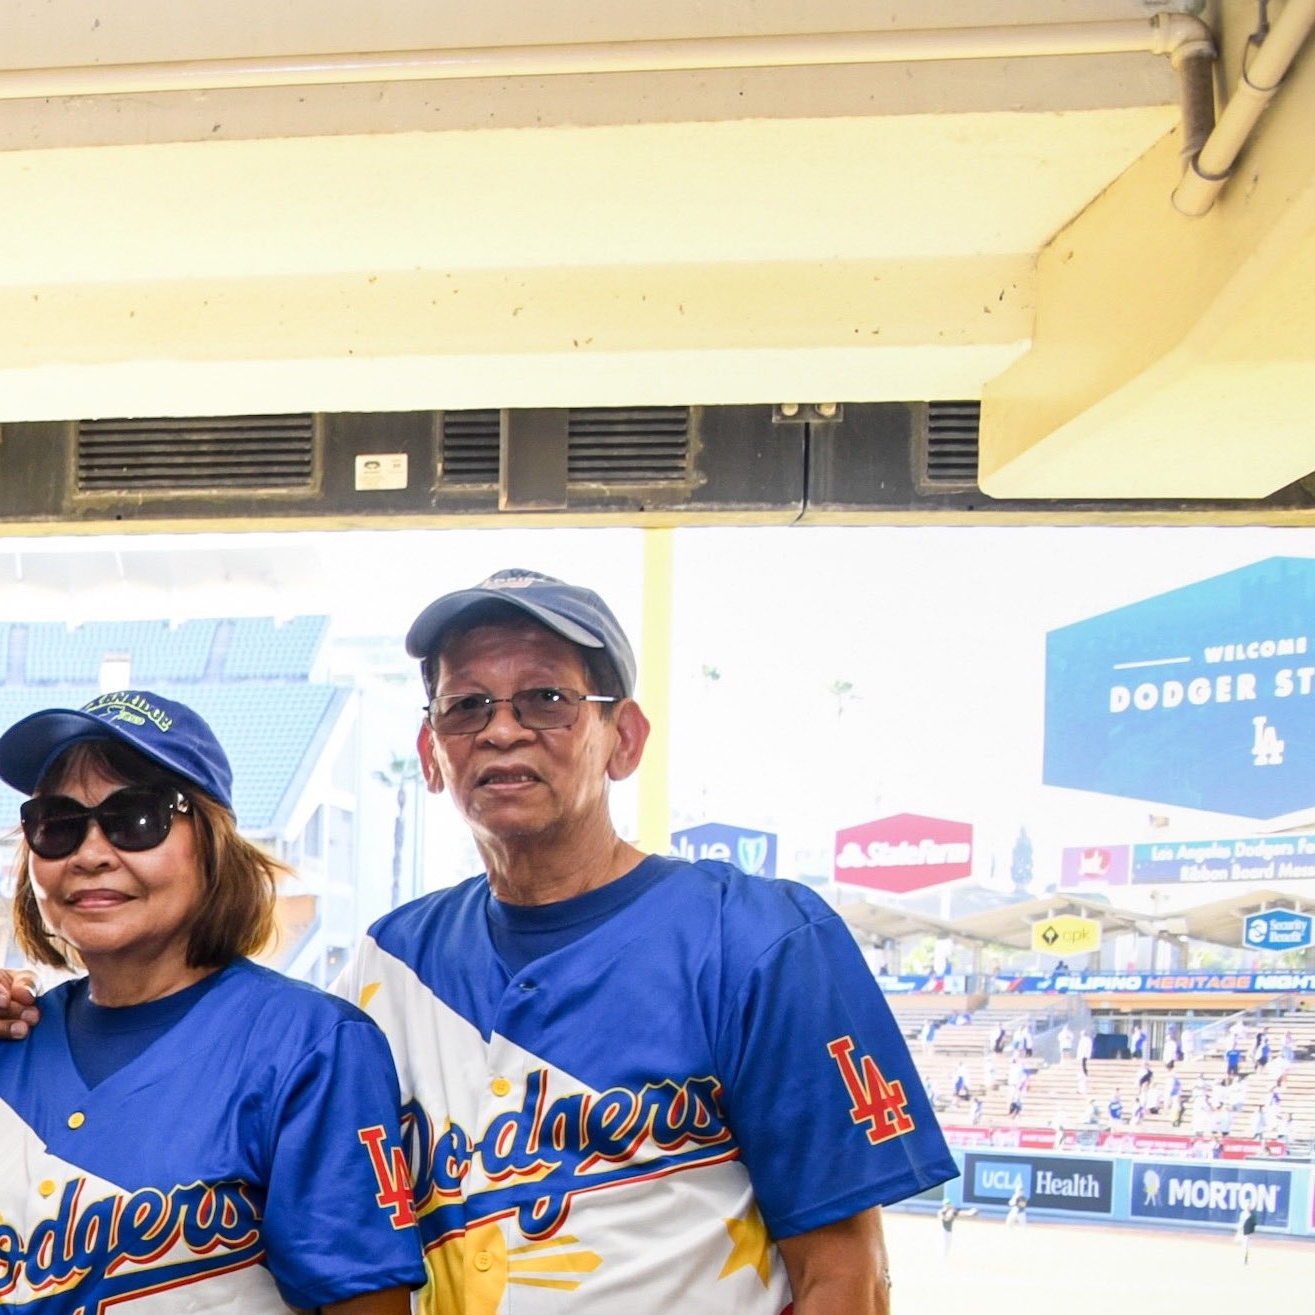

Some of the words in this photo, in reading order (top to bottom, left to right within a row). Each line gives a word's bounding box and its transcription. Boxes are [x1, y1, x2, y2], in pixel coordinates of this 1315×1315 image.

[1204, 637, 1307, 664] WELCOME
[1109, 673, 1257, 713] DODGER
[1251, 715, 1285, 766] LA
[1151, 846, 1174, 861] Los
[1177, 842, 1231, 864] Angeles
[1235, 840, 1295, 862] Dodgers
[1054, 975, 1141, 991] FILIPINO
[1145, 975, 1251, 990] HERITAGE
[827, 1035, 916, 1146] LA
[401, 1069, 733, 1242] Dodgers
[982, 1169, 1021, 1190] UCLA
[1035, 1171, 1099, 1198] Health
[1168, 1178, 1277, 1213] MORTON
